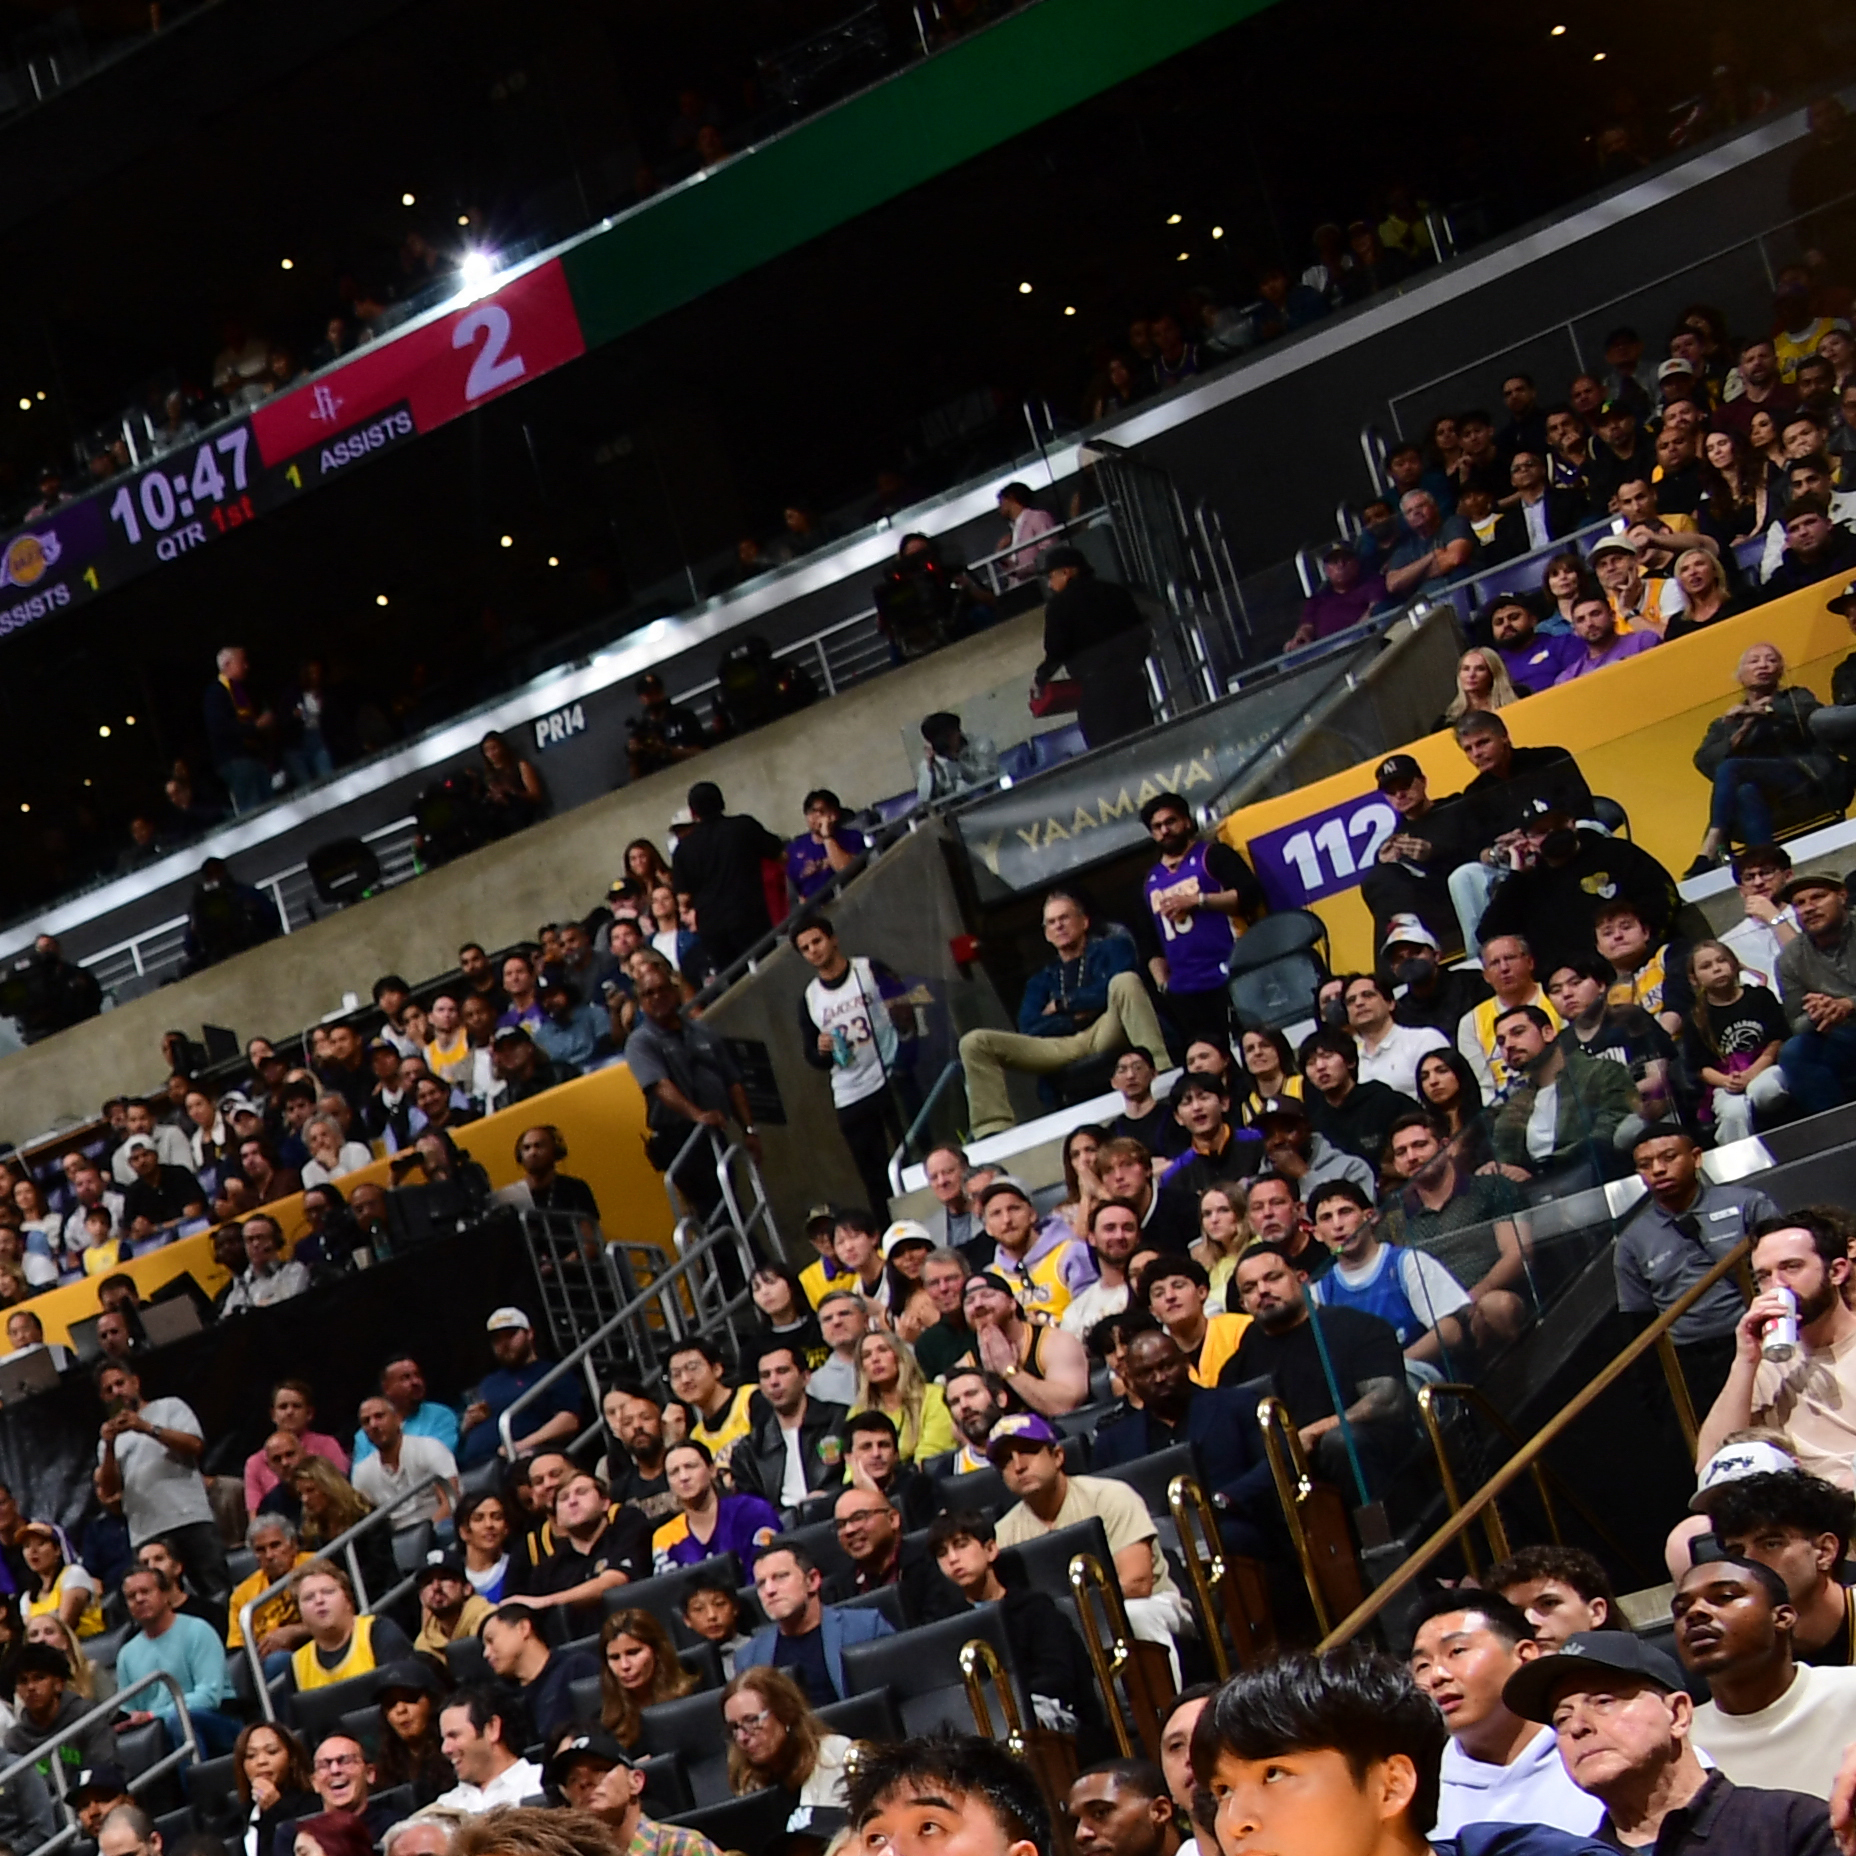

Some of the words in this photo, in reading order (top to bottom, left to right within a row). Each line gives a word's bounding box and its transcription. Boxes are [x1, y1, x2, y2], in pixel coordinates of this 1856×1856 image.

[451, 305, 526, 401] 2
[110, 426, 251, 544] 10:47
[285, 463, 303, 489] 1
[319, 409, 412, 475] ASSISTS
[156, 524, 208, 562] QTR
[210, 497, 255, 536] 1st
[84, 567, 100, 592] 1
[533, 702, 582, 749] PR14
[1283, 803, 1397, 890] 112
